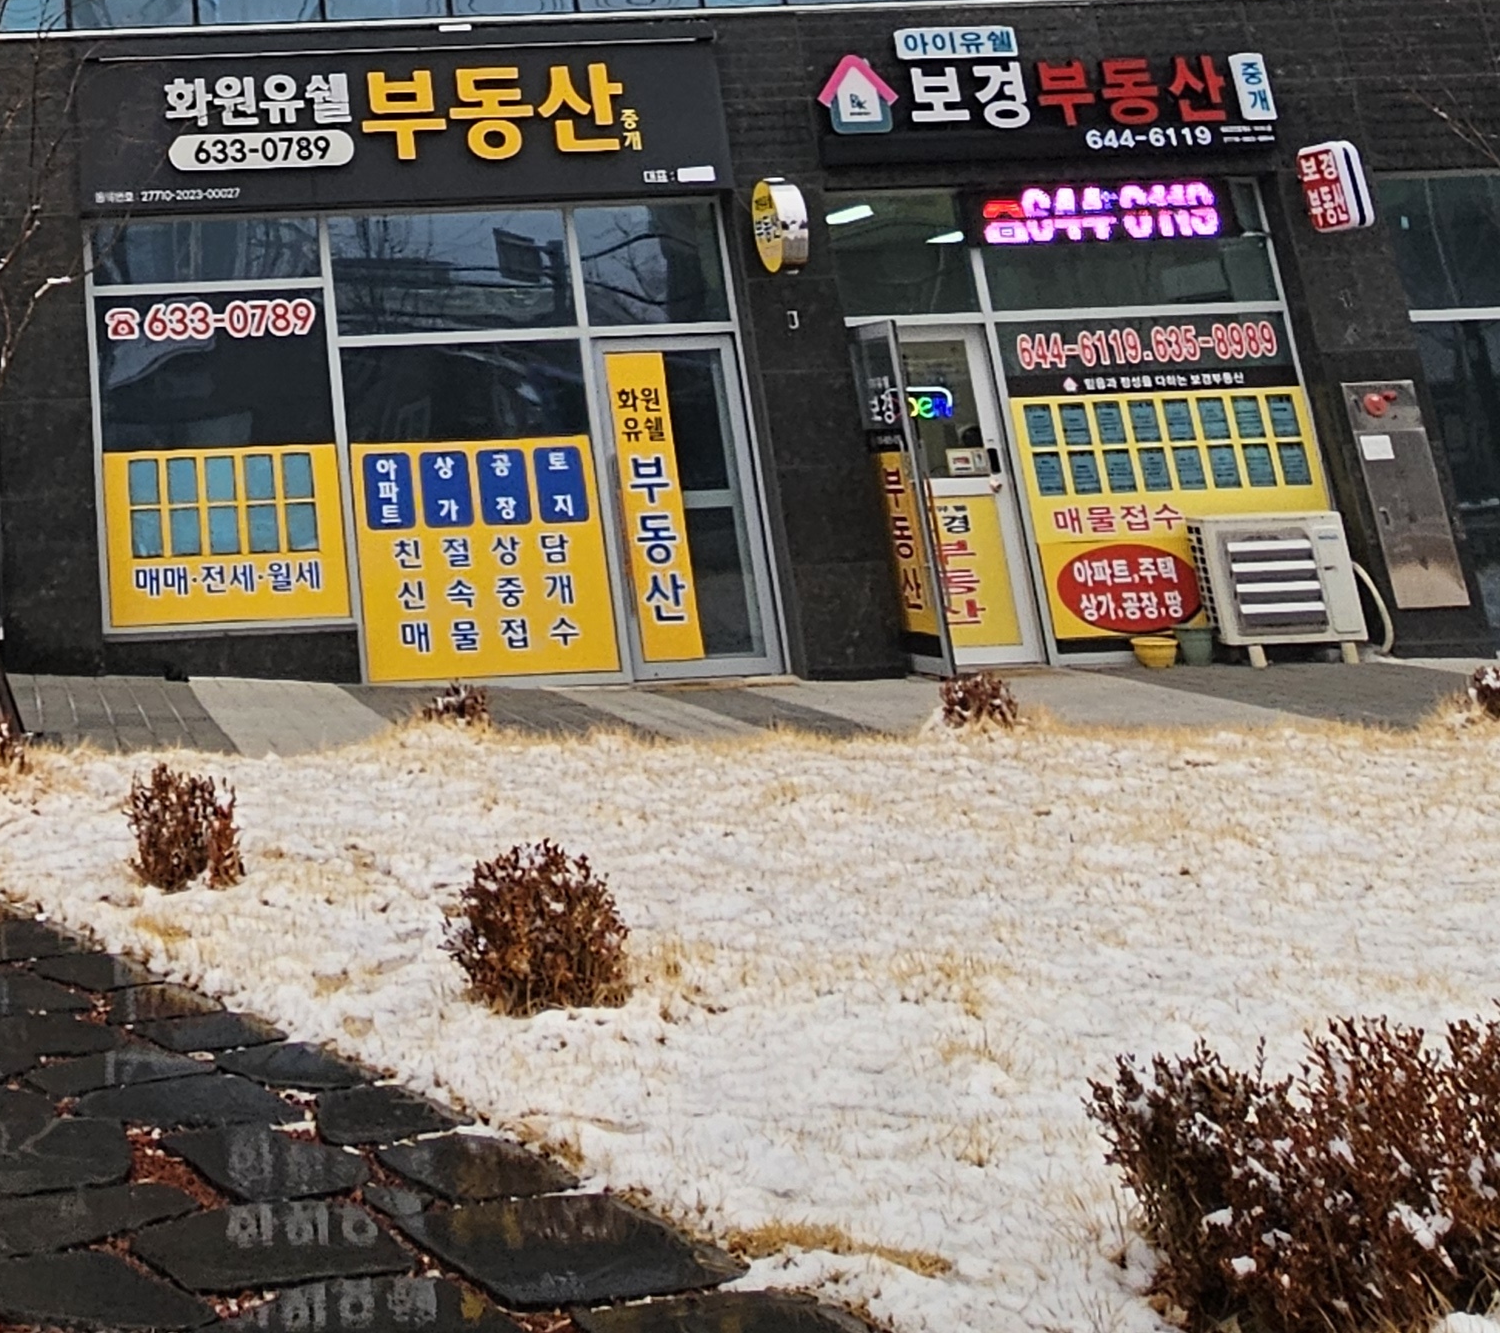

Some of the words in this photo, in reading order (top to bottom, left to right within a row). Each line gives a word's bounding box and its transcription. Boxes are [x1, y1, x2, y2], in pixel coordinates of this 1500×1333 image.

[903, 29, 1014, 55] 아이유쉘
[1240, 61, 1271, 111] 중개
[164, 72, 353, 128] 화원유쉘
[362, 63, 623, 161] 부동산
[620, 108, 643, 151] 중개
[193, 136, 331, 165] 633-0789
[1085, 125, 1212, 150] 644-6119
[1300, 151, 1338, 182] 보경
[1307, 182, 1350, 228] 부동산
[145, 298, 316, 341] 633-0789
[617, 387, 661, 412] 화원
[621, 416, 666, 442] 유쉘
[376, 458, 402, 524] 아파트
[433, 455, 460, 522] 상가
[490, 453, 517, 520] 공장
[547, 451, 575, 517] 토지
[629, 455, 686, 623] 부동산
[1053, 502, 1184, 534] 매물접수
